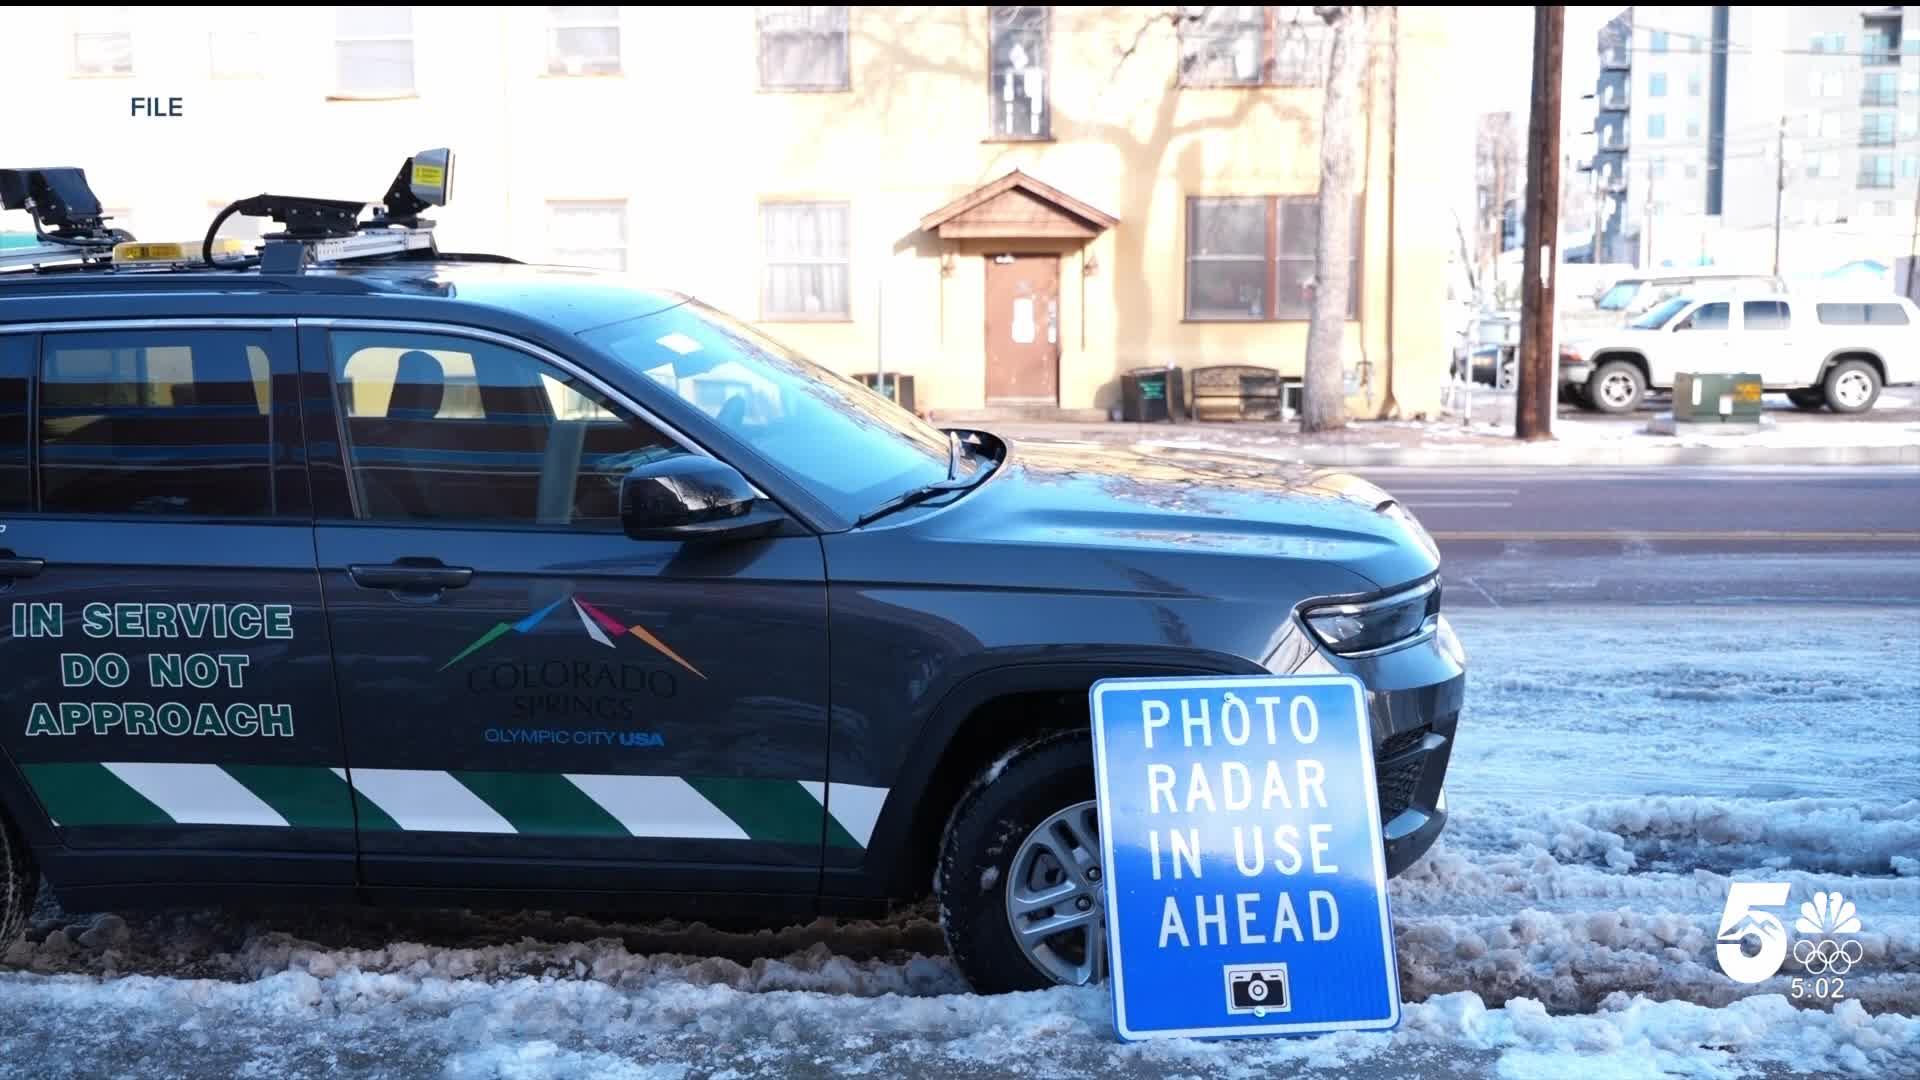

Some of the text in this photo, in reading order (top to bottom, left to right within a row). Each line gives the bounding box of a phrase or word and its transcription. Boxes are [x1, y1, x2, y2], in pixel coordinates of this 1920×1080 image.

[12, 602, 294, 639] IN SERVICE
[60, 653, 249, 688] DO NOT
[467, 660, 678, 700] COLORADO
[25, 702, 294, 737] APPROACH
[513, 695, 633, 720] SPRINGS
[1141, 695, 1319, 748] PHOTO
[484, 728, 665, 747] OLYMPIC CITY USA
[1147, 759, 1328, 814] RADAR
[1149, 824, 1339, 880] IN USE
[1158, 890, 1340, 949] AHEAD
